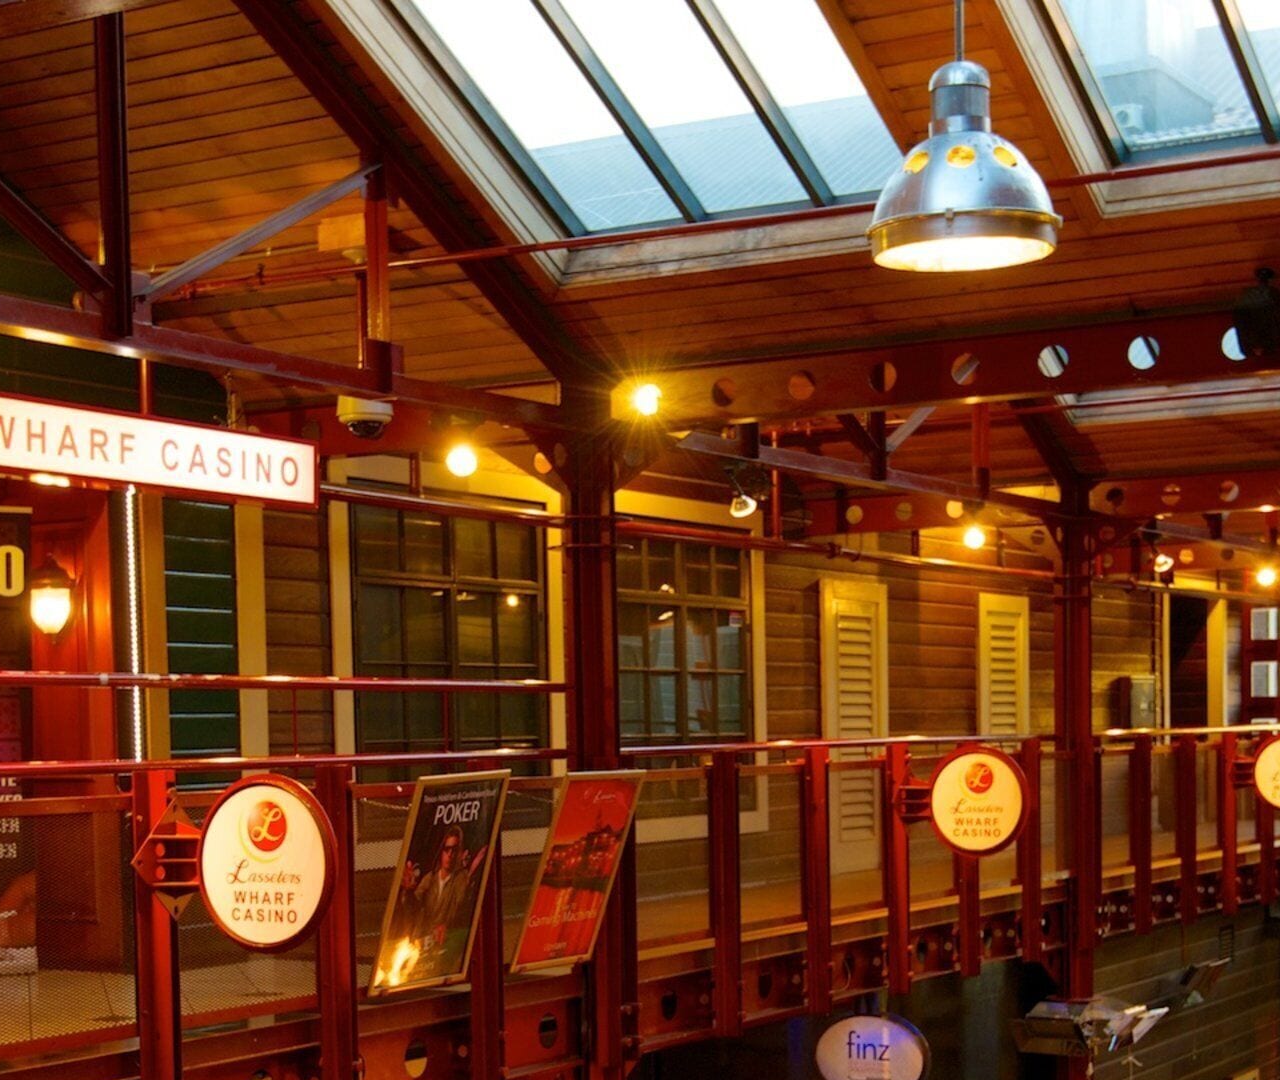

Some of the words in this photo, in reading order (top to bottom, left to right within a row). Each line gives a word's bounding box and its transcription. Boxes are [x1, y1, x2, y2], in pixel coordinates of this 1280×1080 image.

[161, 438, 300, 487] CASINO
[433, 800, 481, 826] POKER
[954, 817, 1000, 827] WHARF
[952, 828, 1002, 838] CASINO
[226, 859, 302, 884] Lasseters
[234, 890, 296, 906] WHARF
[231, 907, 299, 924] CASINO
[846, 1030, 891, 1061] finz
